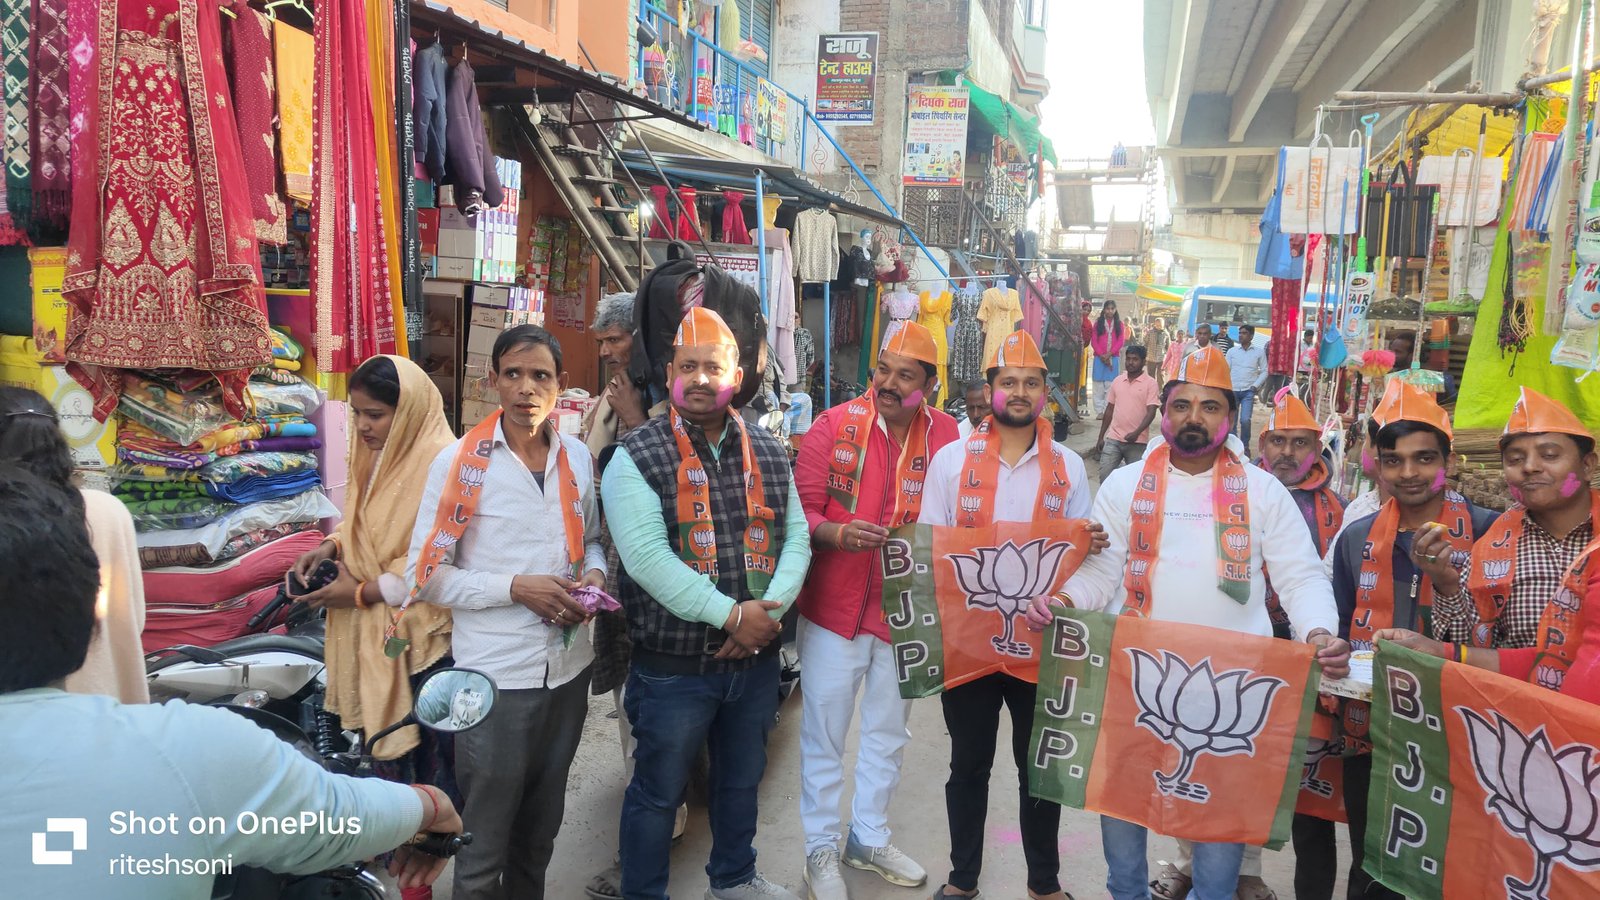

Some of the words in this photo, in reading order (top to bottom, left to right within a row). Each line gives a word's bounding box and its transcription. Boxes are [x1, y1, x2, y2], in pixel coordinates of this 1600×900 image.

[825, 37, 872, 59] राजू
[819, 58, 840, 76] टेन्ट
[843, 61, 873, 76] हाउस
